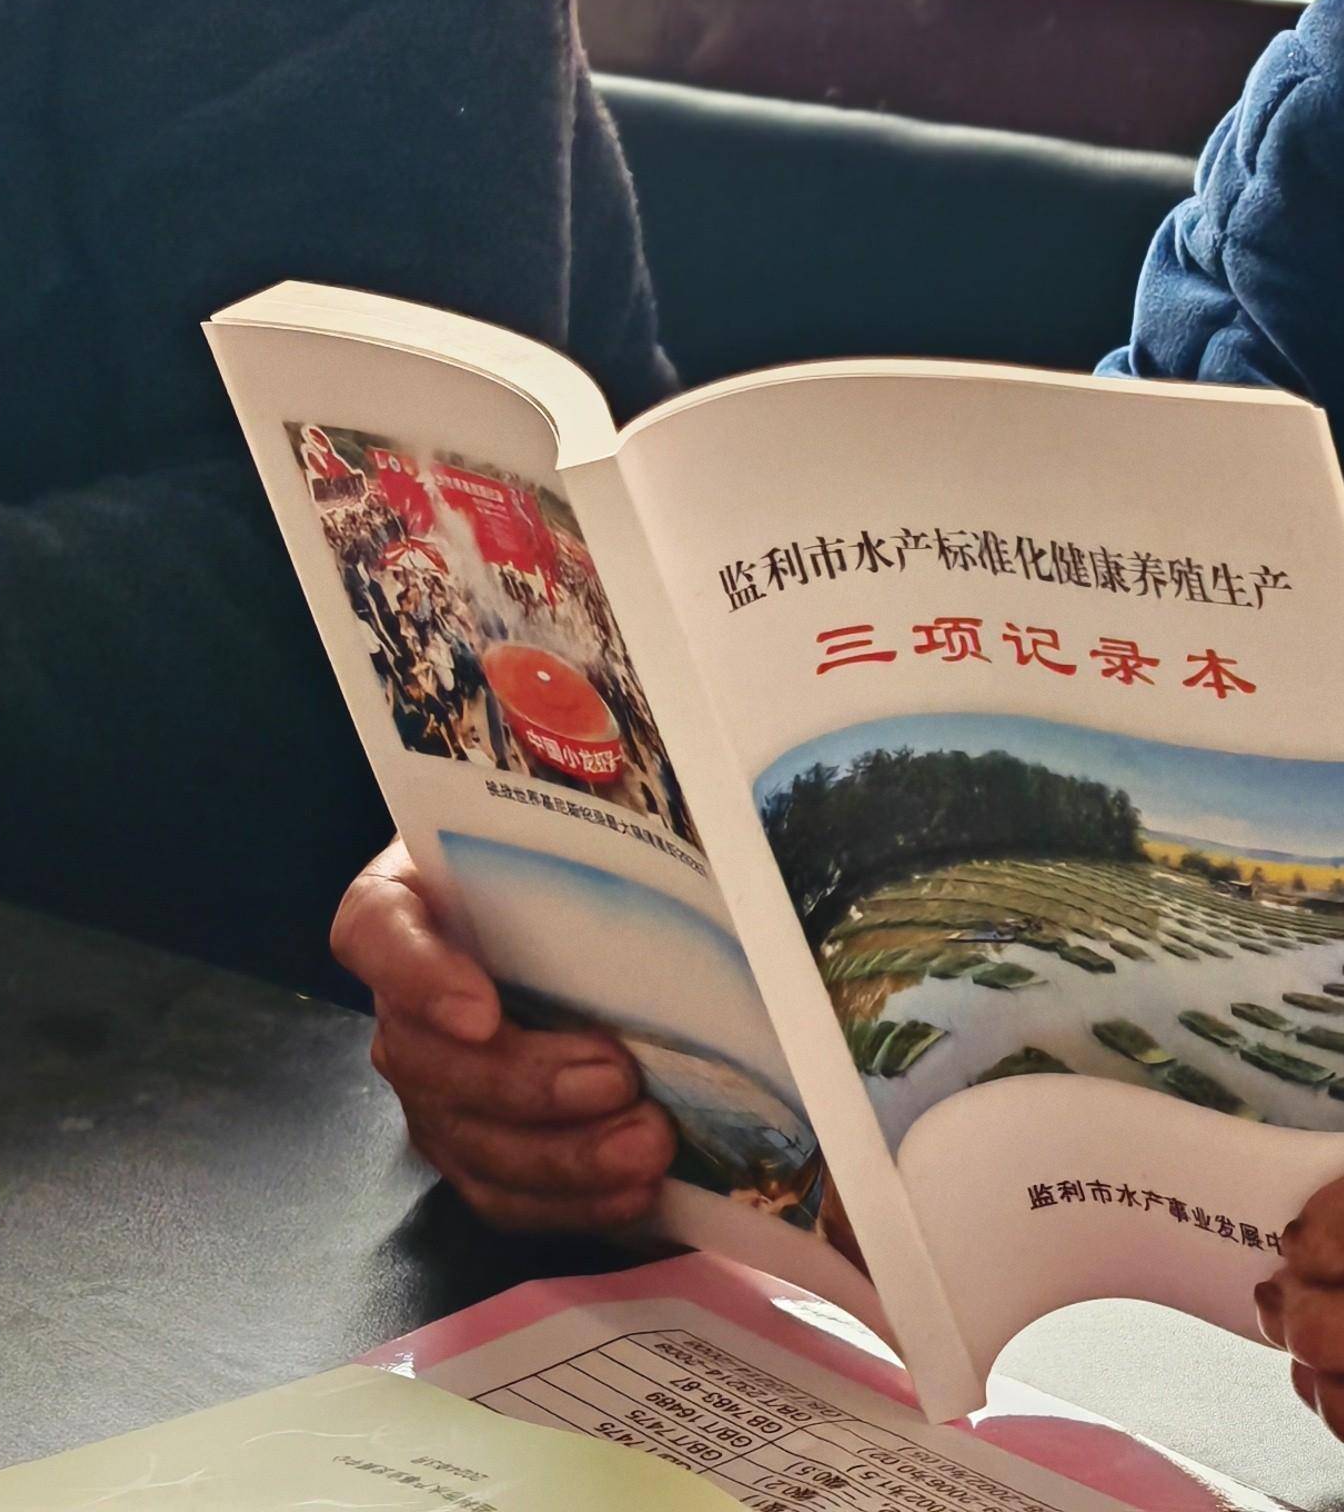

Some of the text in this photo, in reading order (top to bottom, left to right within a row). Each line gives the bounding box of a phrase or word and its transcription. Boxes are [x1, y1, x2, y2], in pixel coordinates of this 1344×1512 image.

[718, 527, 1293, 614] 监利市水产标准化健康养殖生产
[814, 616, 1258, 699] 三项记录本
